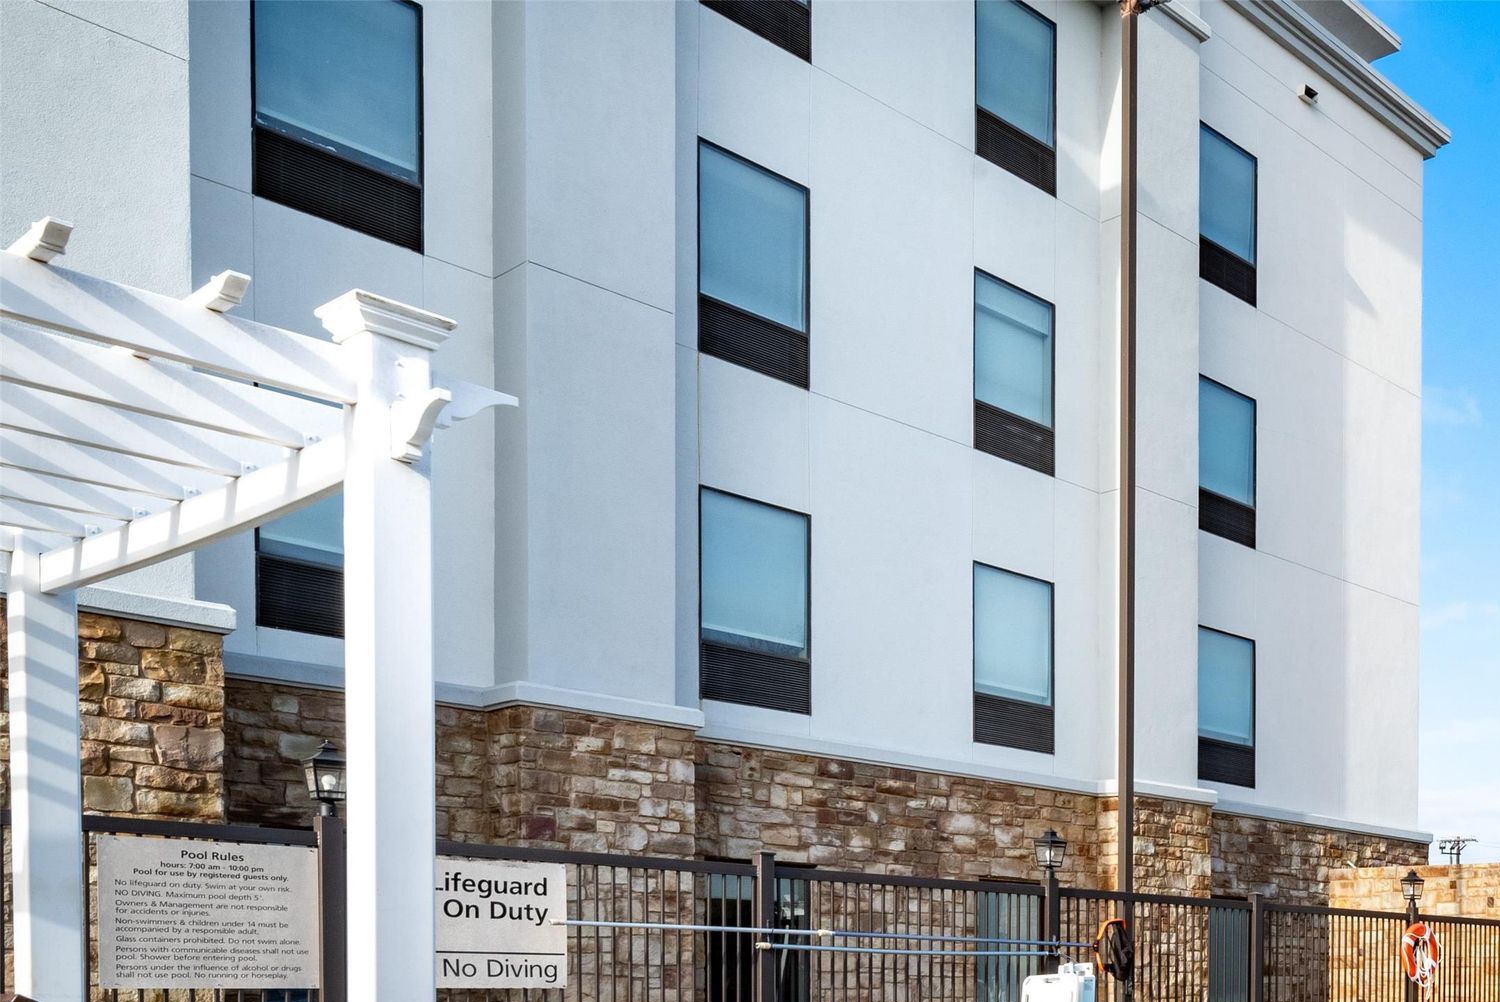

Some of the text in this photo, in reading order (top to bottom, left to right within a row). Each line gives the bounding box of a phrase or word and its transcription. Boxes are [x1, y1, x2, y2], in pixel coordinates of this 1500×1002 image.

[181, 850, 244, 862] Pool Rules
[160, 860, 186, 868] hours:
[186, 870, 197, 878] by
[130, 880, 166, 888] lifeguard
[160, 901, 213, 909] Management
[444, 899, 548, 926] On Duty
[443, 958, 557, 983] No Diving
